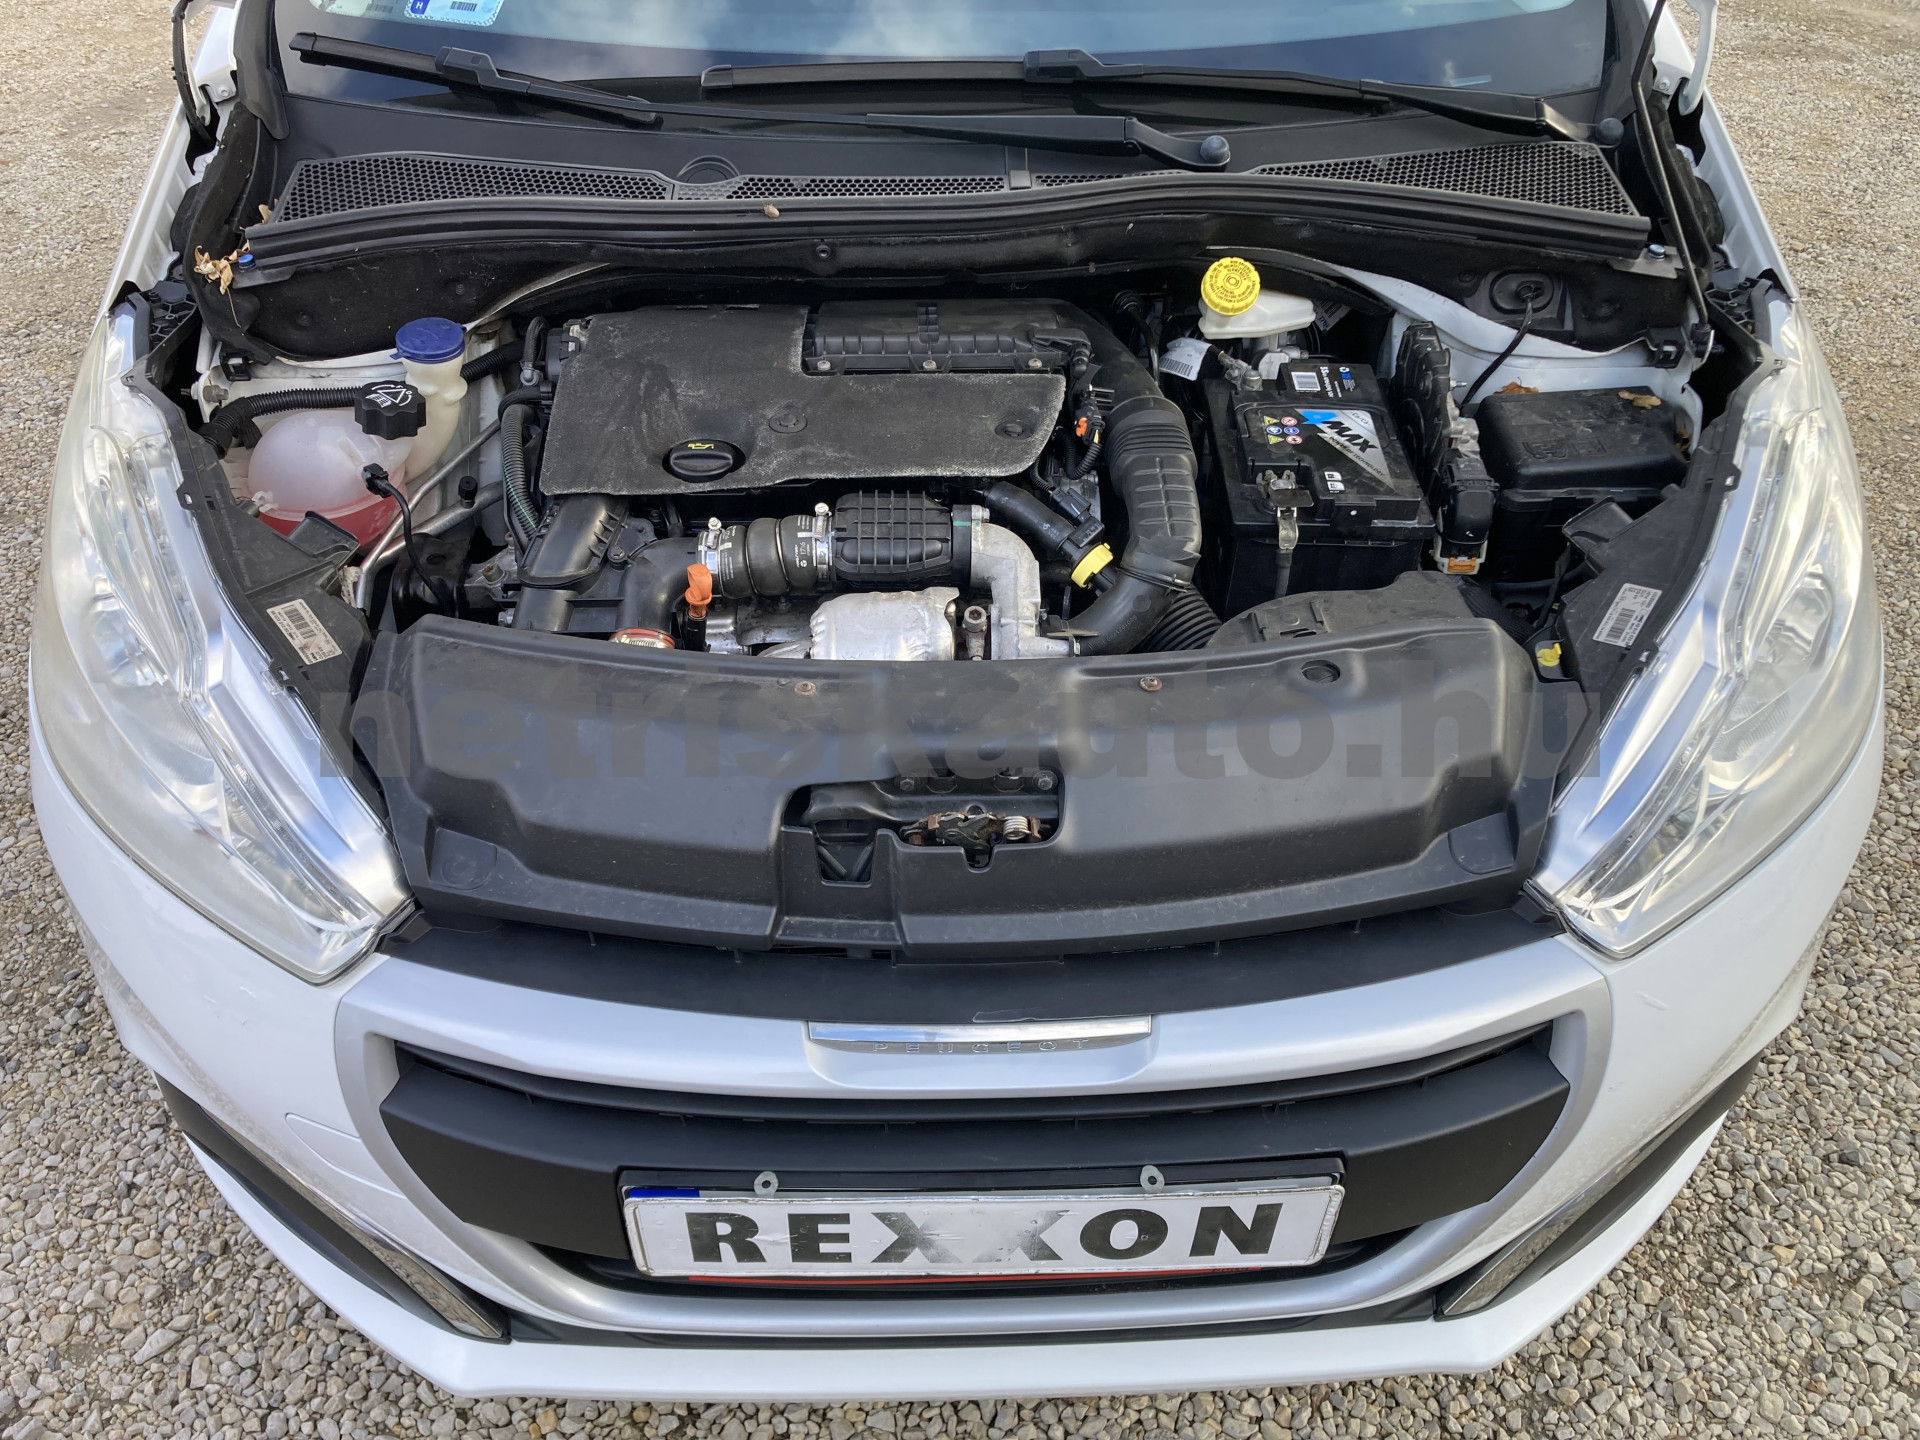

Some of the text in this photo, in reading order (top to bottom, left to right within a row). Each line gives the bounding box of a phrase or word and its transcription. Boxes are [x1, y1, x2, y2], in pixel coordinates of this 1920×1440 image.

[415, 1, 423, 10] H
[872, 1038, 1089, 1054] PEUGEOT
[685, 1203, 1284, 1264] REXXON
